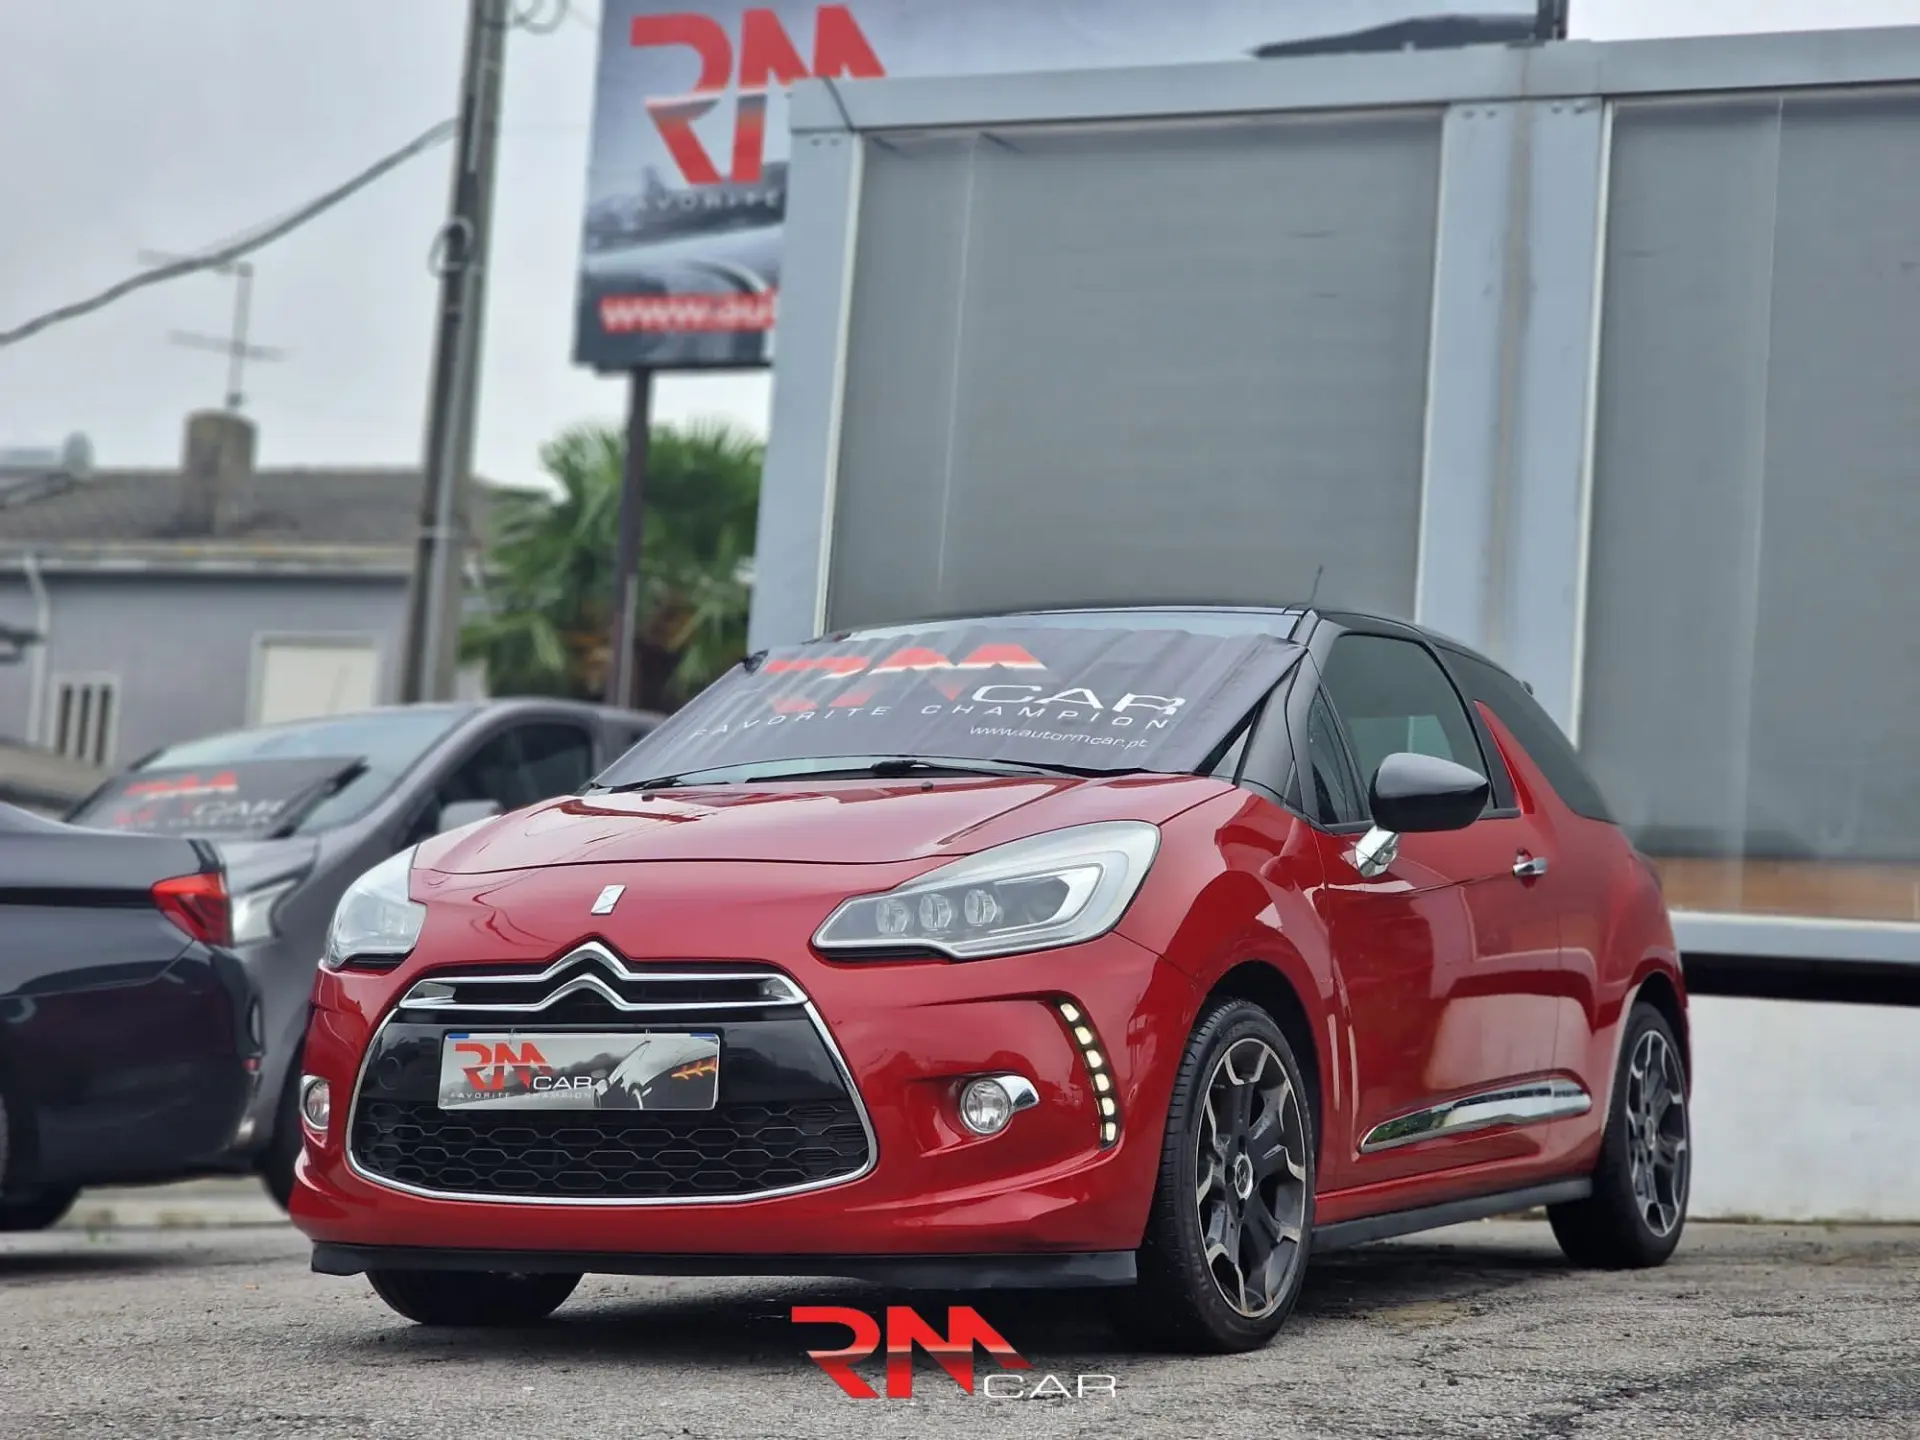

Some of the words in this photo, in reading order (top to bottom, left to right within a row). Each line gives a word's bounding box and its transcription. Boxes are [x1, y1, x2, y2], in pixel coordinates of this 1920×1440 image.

[971, 684, 1186, 716] CAR
[688, 706, 892, 741] FAVORITE
[920, 704, 1169, 731] CHAMPION
[969, 725, 1149, 749] www.autormcar.pt
[454, 1042, 553, 1091] RM
[532, 1075, 593, 1091] CAR
